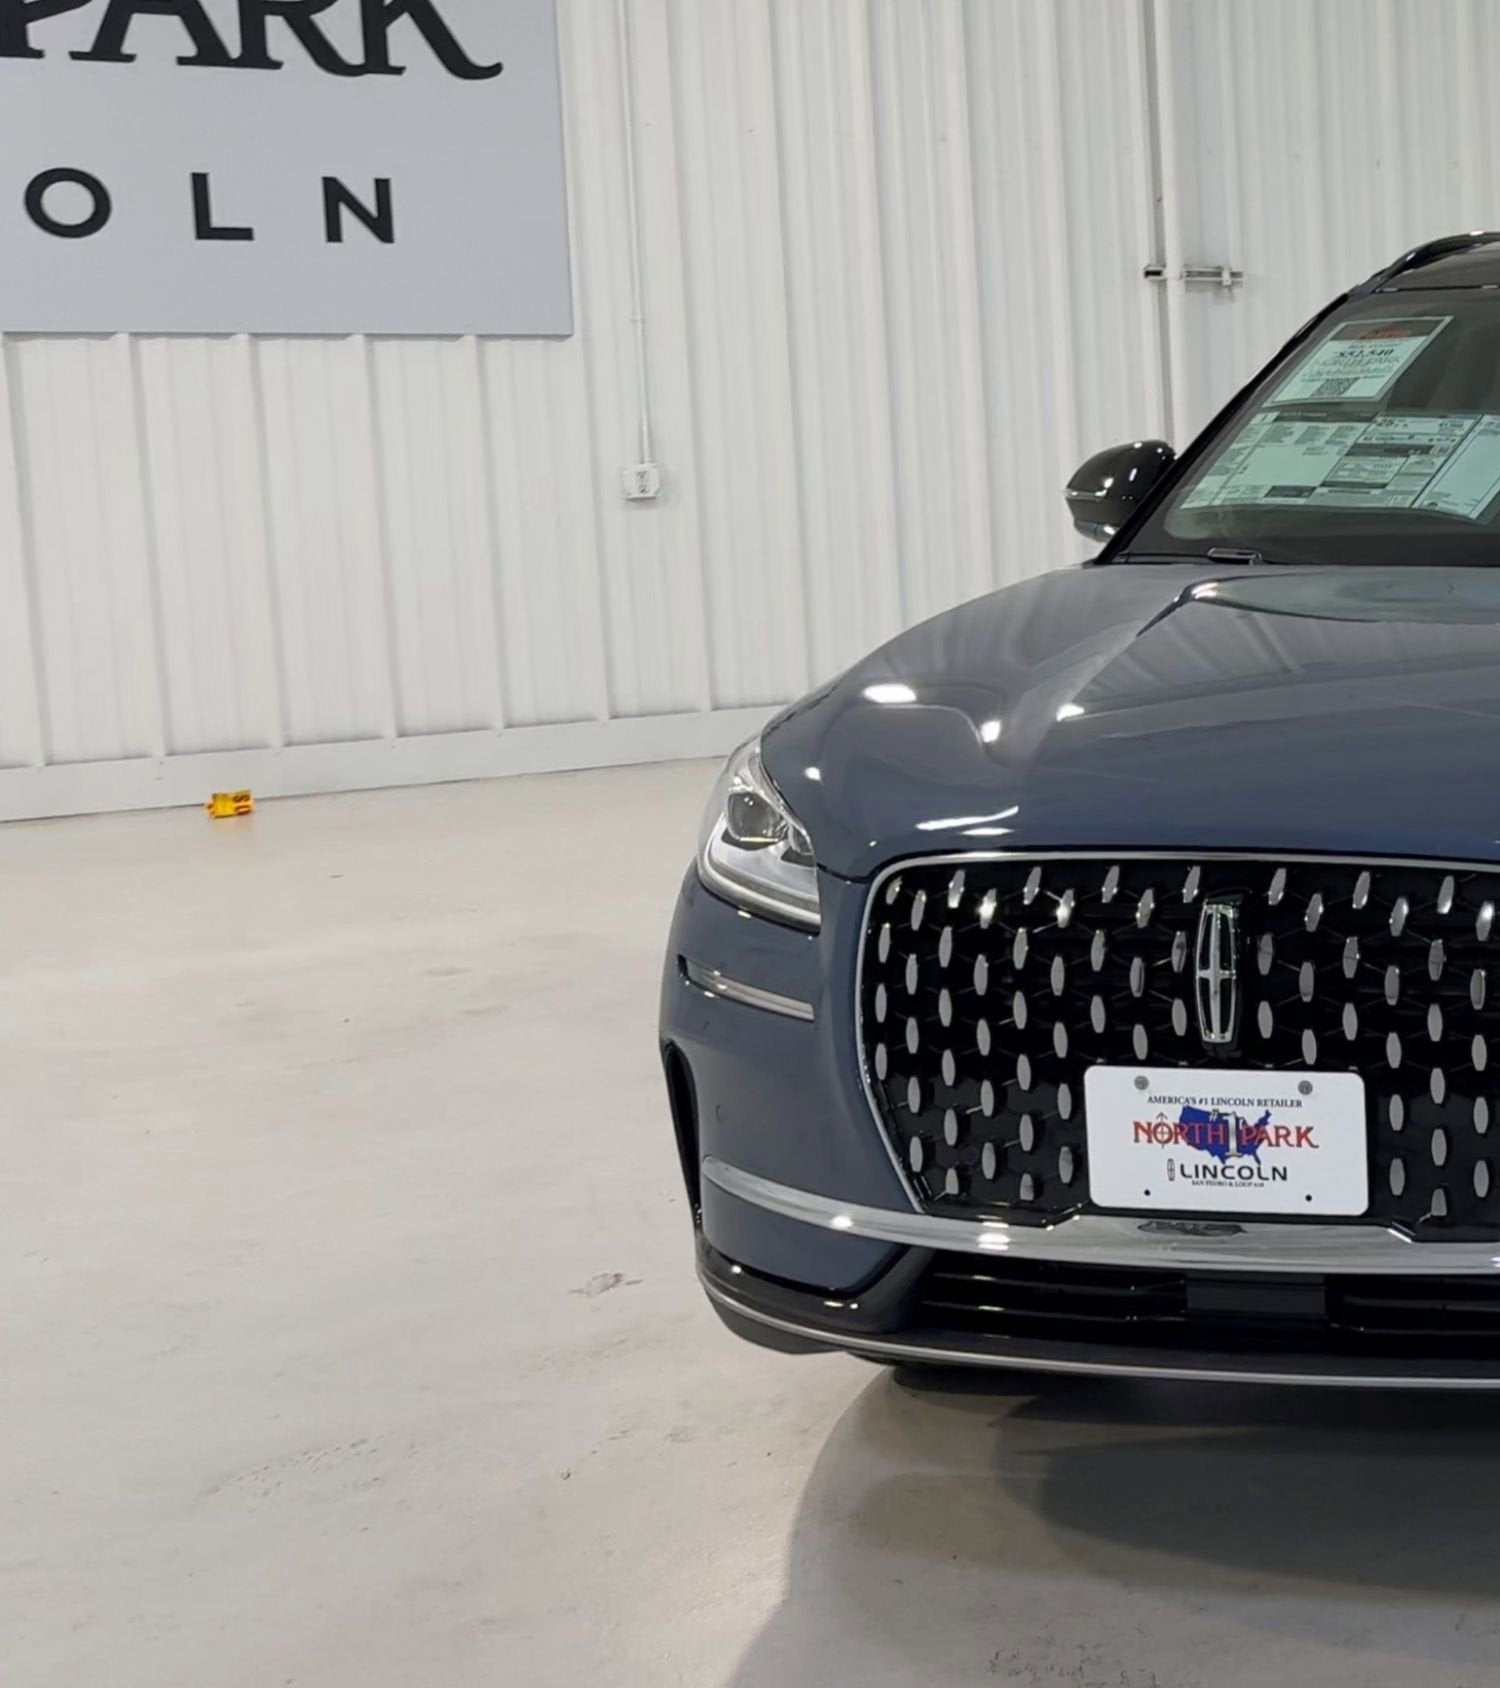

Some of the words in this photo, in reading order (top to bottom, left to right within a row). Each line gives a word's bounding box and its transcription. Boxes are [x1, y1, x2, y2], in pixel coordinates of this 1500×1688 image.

[1147, 1095, 1197, 1105] AMERICA'S
[1198, 1097, 1208, 1105] #1
[1210, 1097, 1255, 1107] LINCOLN
[1256, 1098, 1303, 1108] RETAILER
[1133, 1120, 1225, 1145] NORTH
[1241, 1124, 1320, 1149] PARK
[1180, 1163, 1288, 1181] LINCOLN
